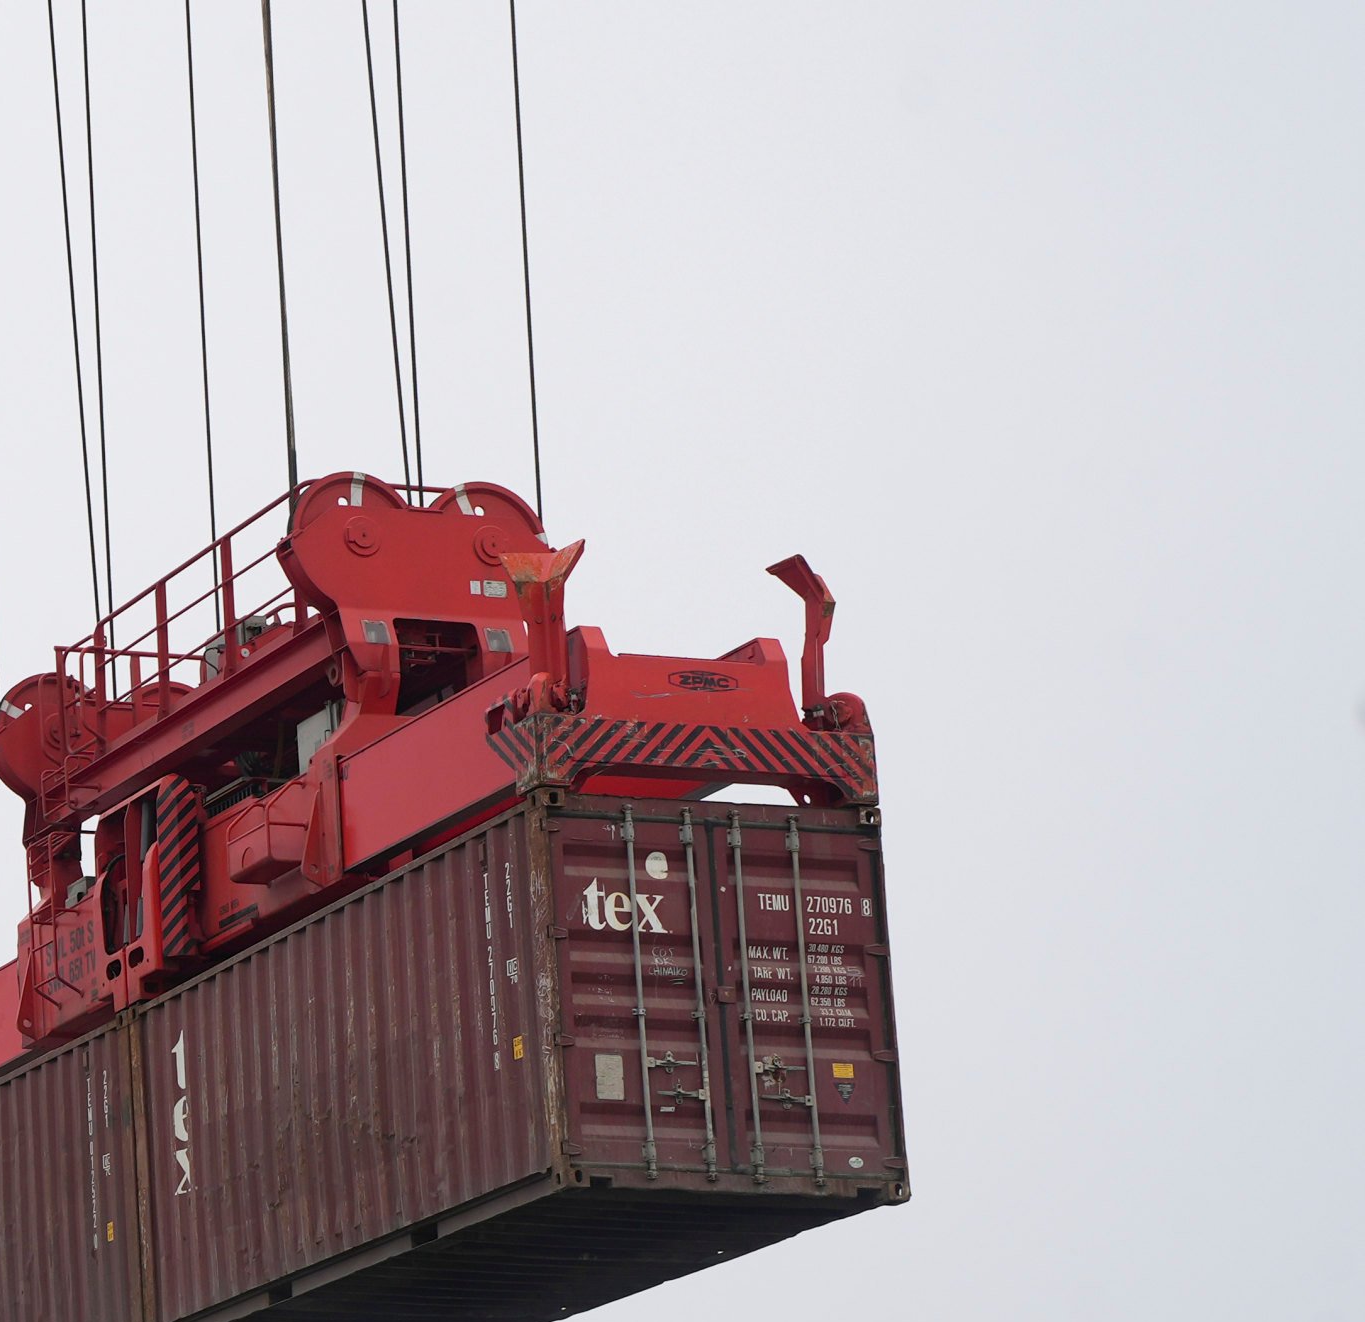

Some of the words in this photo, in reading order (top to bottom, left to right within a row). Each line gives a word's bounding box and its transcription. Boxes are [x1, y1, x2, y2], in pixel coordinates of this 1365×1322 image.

[679, 675, 730, 688] ZPMC
[505, 863, 513, 928] 22G1
[483, 873, 492, 939] TEMU
[583, 877, 669, 933] tex
[758, 894, 789, 911] TEMU
[806, 896, 852, 914] 270976
[862, 899, 871, 916] 8
[808, 918, 838, 935] 22G1
[748, 946, 771, 960] MAX.
[773, 947, 789, 960] WT.
[831, 945, 844, 954] KGS
[831, 956, 842, 965] LBS
[776, 968, 793, 980] WT.
[835, 976, 847, 985] LBS
[487, 946, 498, 1045] 270976
[752, 988, 788, 1002] PAYLOAD
[834, 987, 847, 996] KGS
[834, 998, 845, 1007] LBS
[755, 1009, 769, 1021] CU.
[772, 1010, 790, 1022] CAP.
